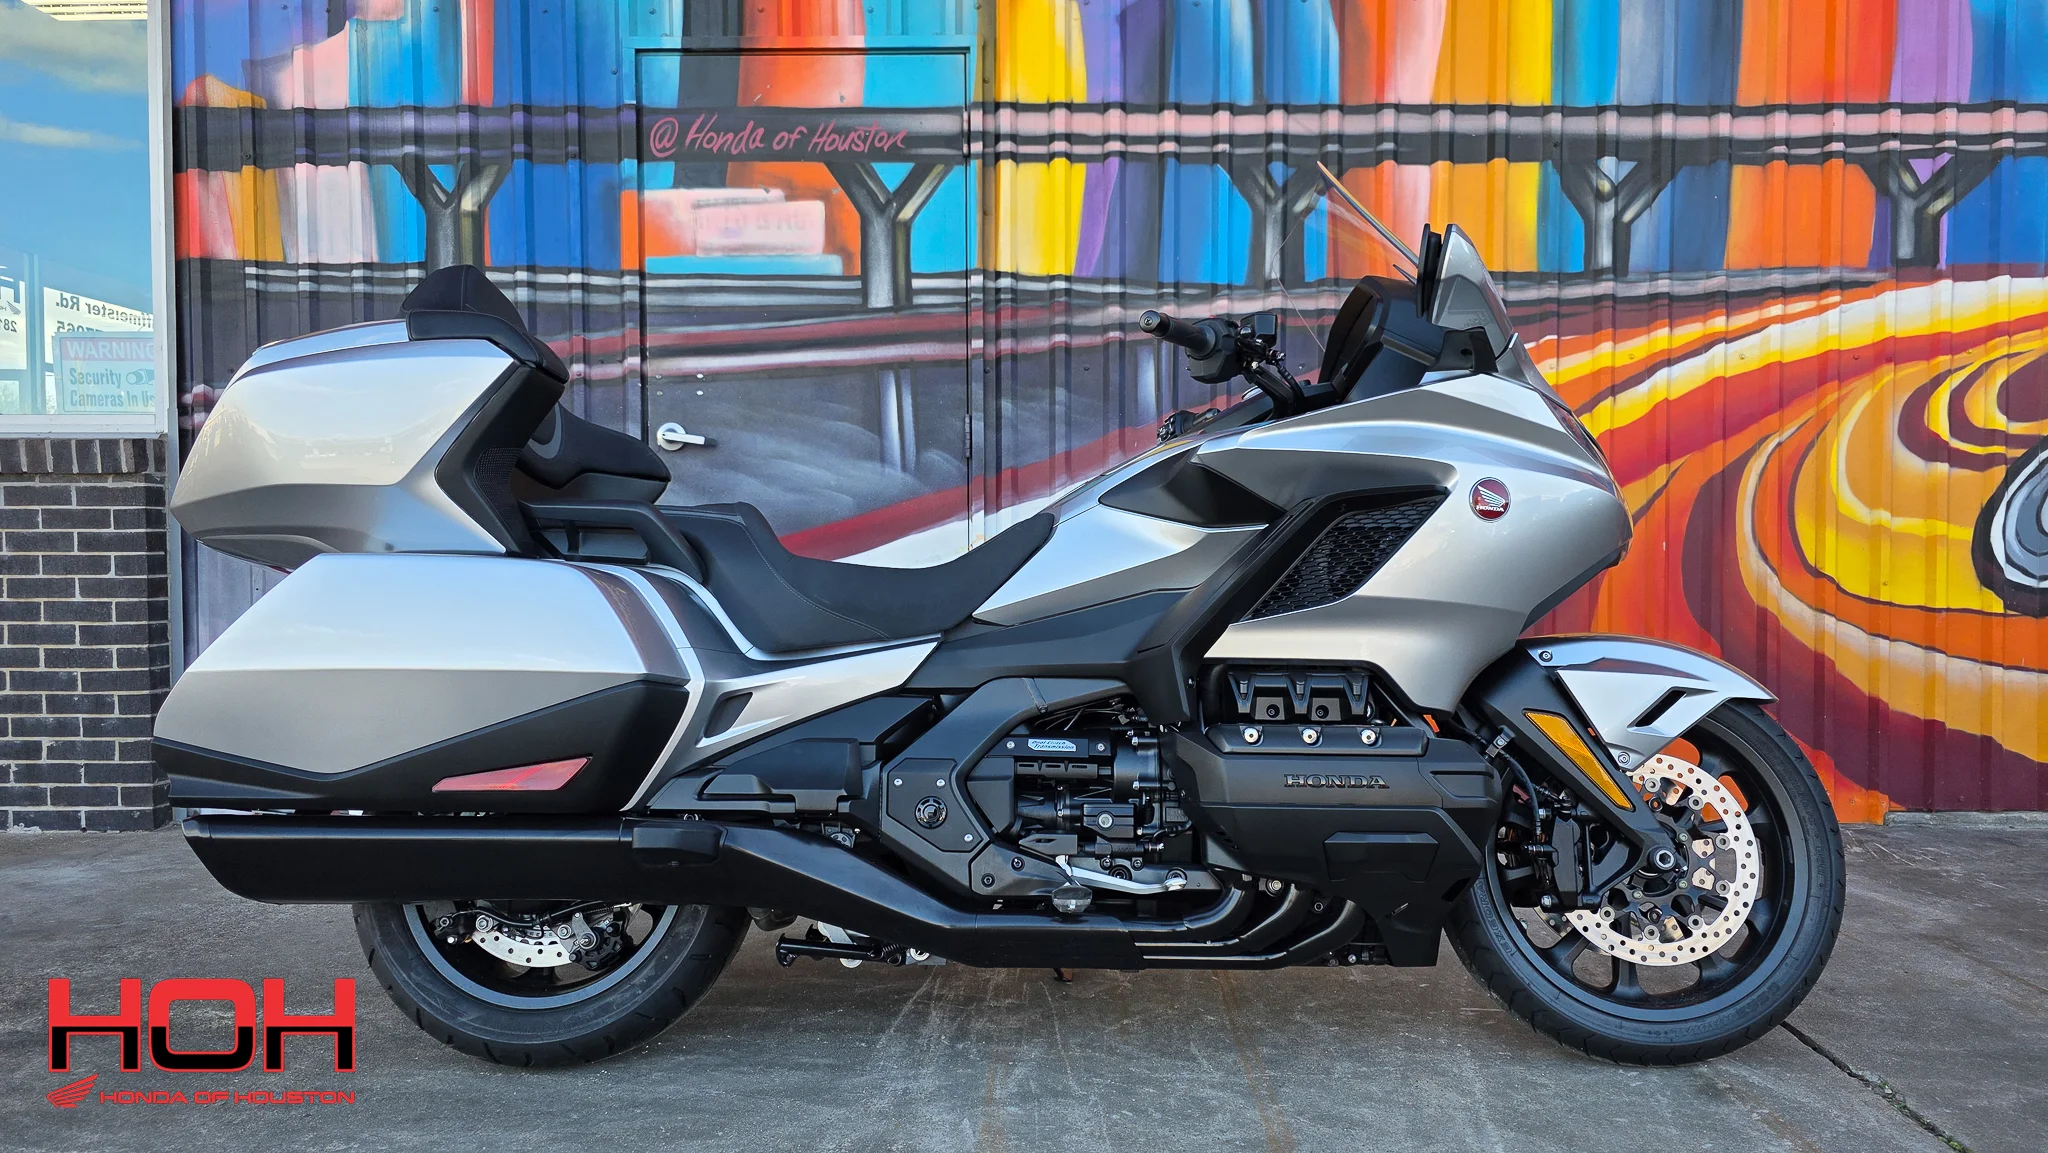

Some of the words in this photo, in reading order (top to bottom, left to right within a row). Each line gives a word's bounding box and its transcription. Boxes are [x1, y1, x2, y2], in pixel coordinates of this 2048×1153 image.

[650, 117, 679, 158] @
[685, 112, 765, 155] Honda
[772, 126, 808, 151] of
[808, 119, 907, 154] Houston
[69, 367, 121, 389] Security
[70, 389, 124, 407] Cameras
[127, 391, 139, 407] In
[1284, 774, 1390, 789] HONDA
